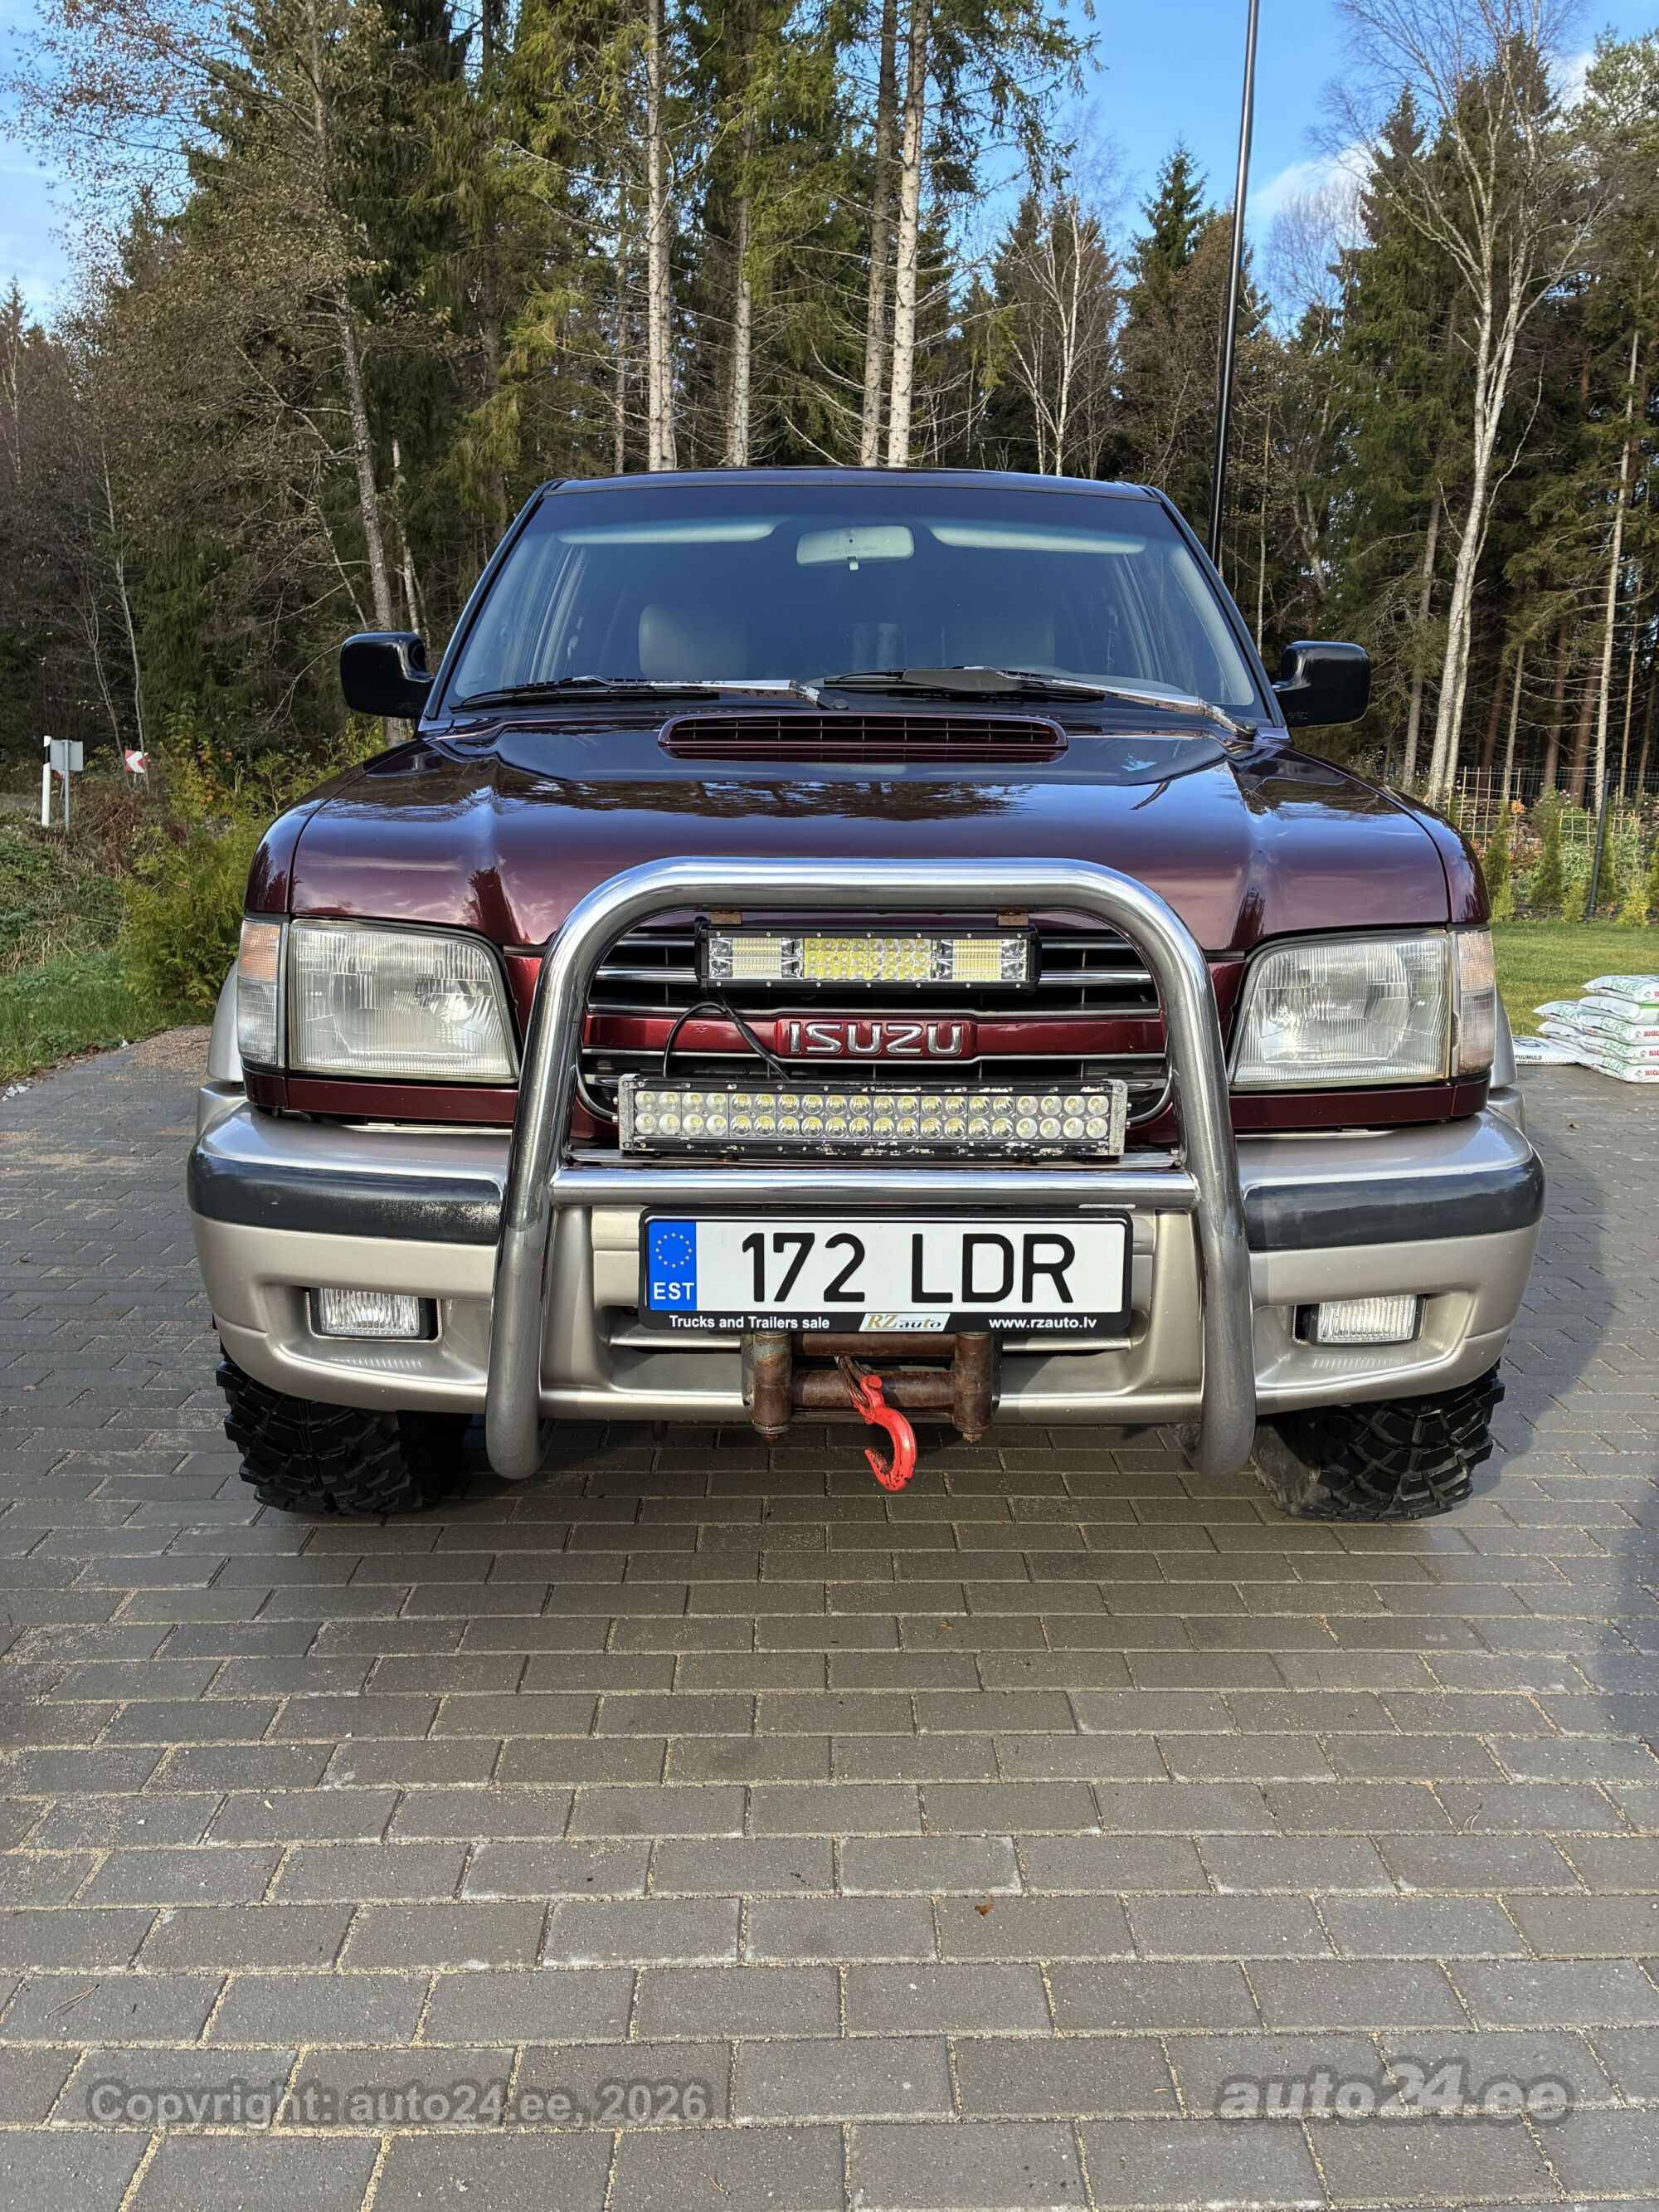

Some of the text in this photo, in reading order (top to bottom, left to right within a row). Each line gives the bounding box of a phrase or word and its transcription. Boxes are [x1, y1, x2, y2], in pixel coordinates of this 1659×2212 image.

[790, 1022, 962, 1055] ISUZU
[742, 1232, 1076, 1303] 172 LDR
[653, 1282, 695, 1300] EST
[669, 1315, 830, 1329] Trucks and Trailers sale
[867, 1314, 942, 1329] RZ auto
[989, 1317, 1097, 1329] www.rzauto.lv
